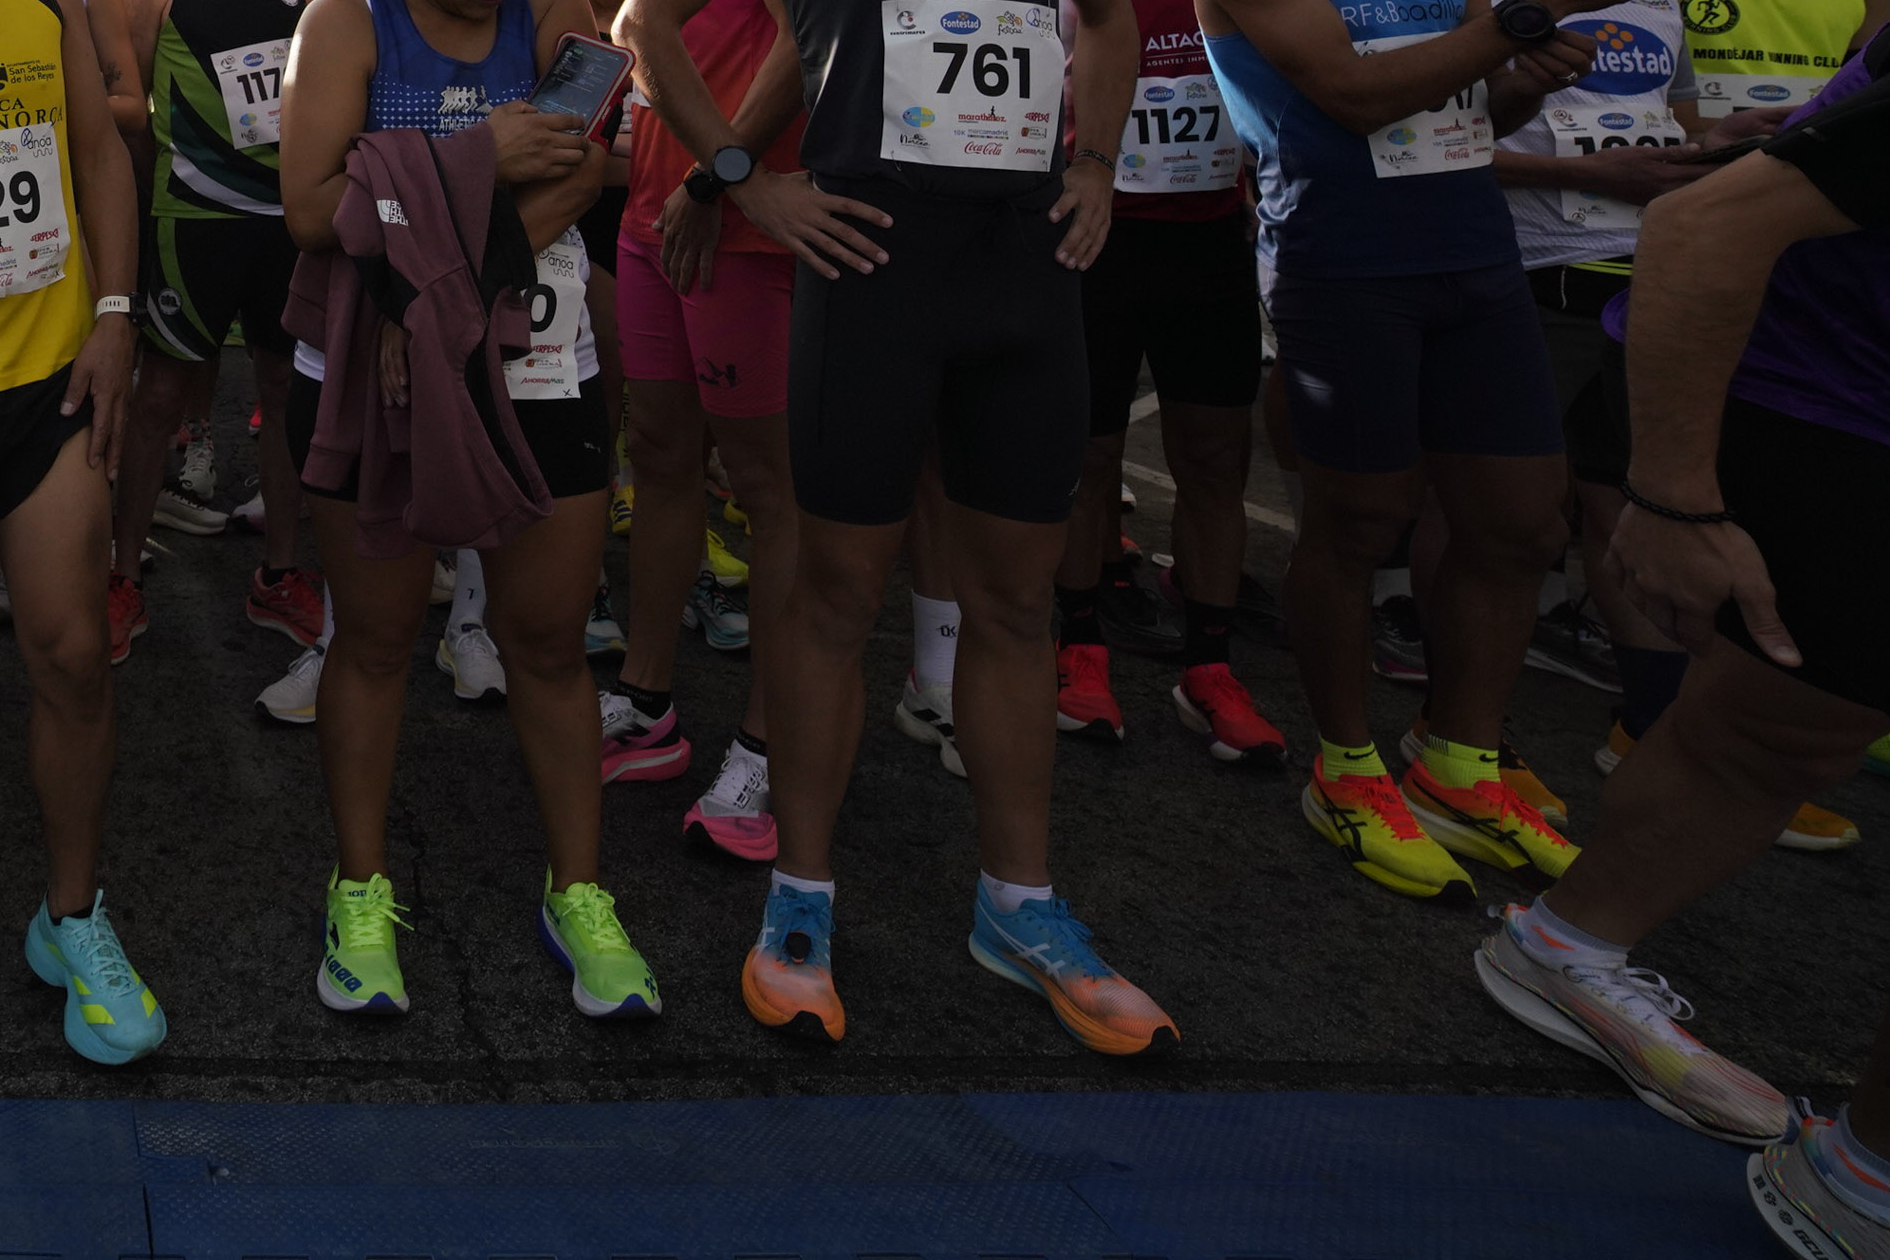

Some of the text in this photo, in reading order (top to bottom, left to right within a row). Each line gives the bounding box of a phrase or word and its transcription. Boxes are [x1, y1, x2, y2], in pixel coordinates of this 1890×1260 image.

[942, 17, 979, 29] Fontestad
[1146, 58, 1184, 67] AGENTES
[8, 67, 26, 76] San
[932, 41, 1031, 99] 761
[10, 71, 55, 84] de los Reyes
[236, 66, 287, 105] 117
[1131, 105, 1220, 145] 1127
[27, 136, 52, 149] anoa
[548, 256, 574, 270] anoa
